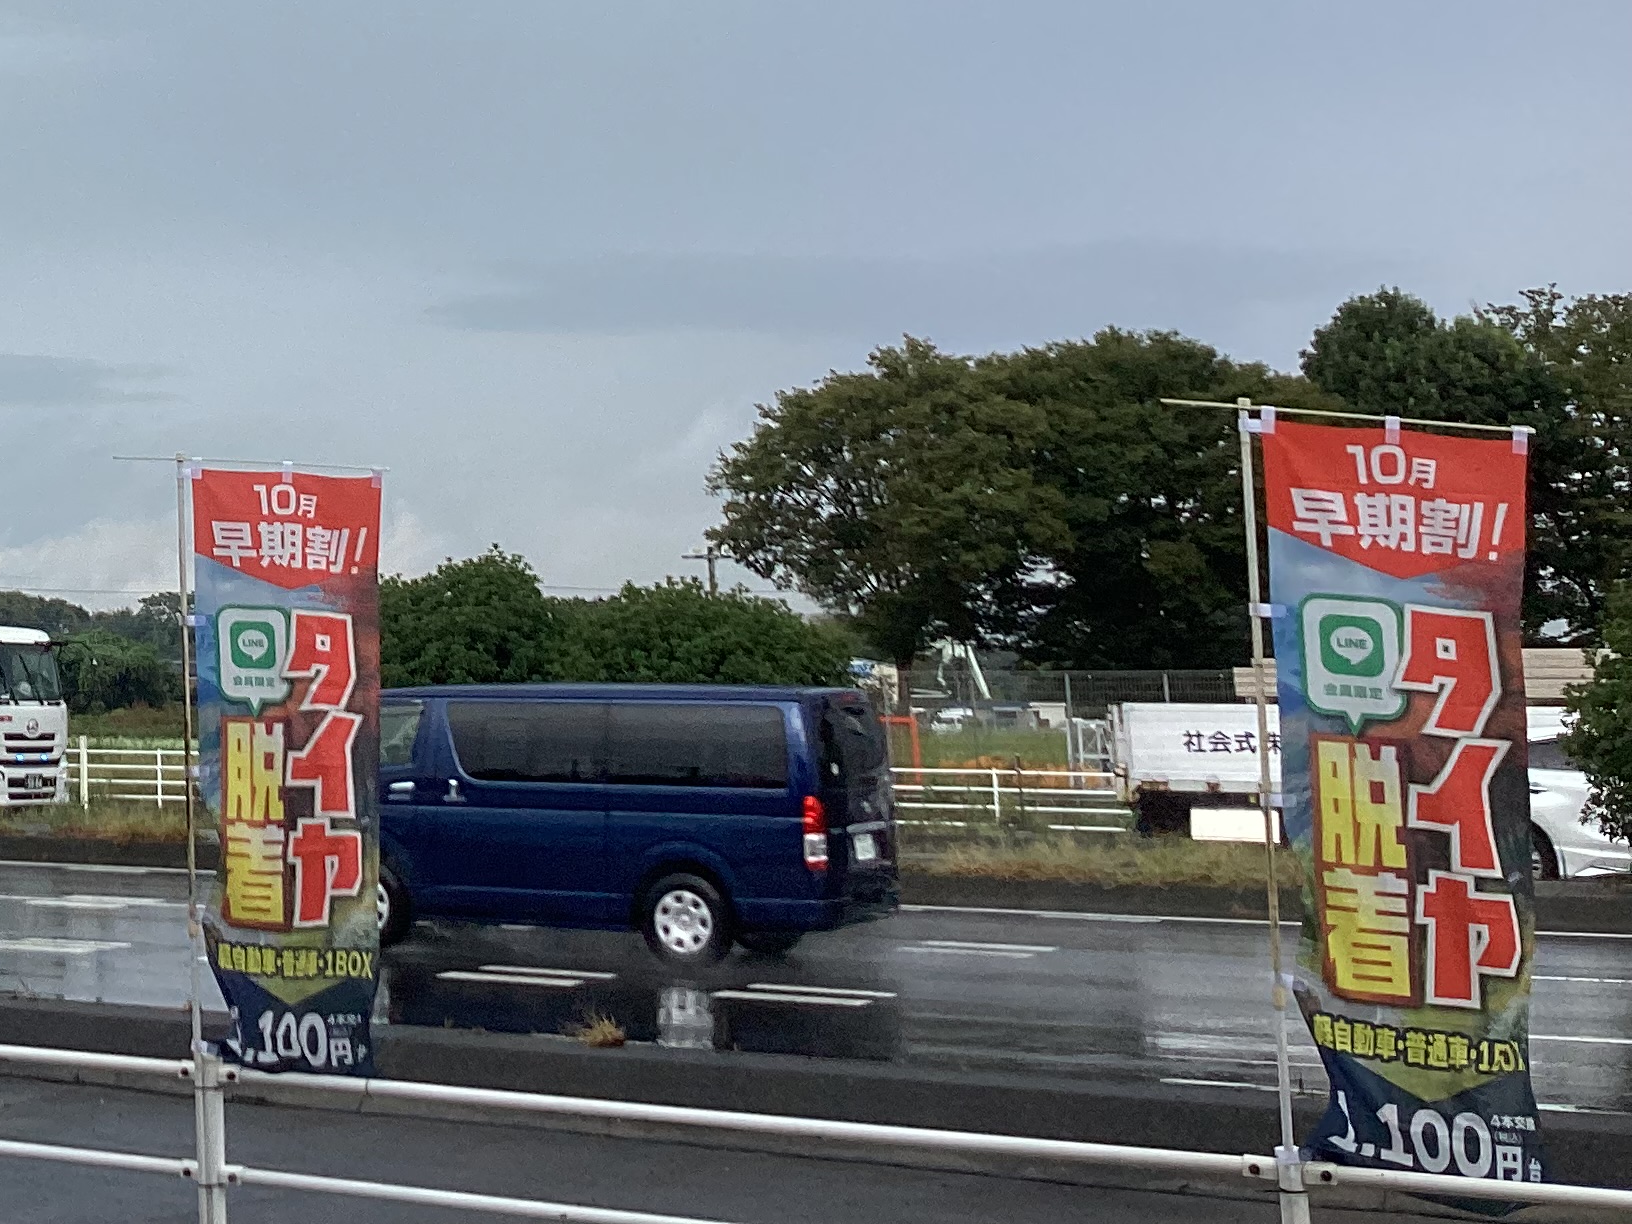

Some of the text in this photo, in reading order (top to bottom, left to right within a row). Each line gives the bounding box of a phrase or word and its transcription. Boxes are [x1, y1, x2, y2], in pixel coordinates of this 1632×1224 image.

[1346, 443, 1437, 489] 10月
[253, 484, 317, 518] 10月
[1290, 487, 1509, 562] 早期割!
[212, 520, 367, 574] 早期割!
[241, 637, 265, 649] LINE
[1336, 636, 1369, 651] LINE
[280, 608, 364, 927] タイヤ
[226, 721, 285, 923] 脱着
[1392, 603, 1522, 1010] タイヤ
[1318, 740, 1411, 996] 脱着
